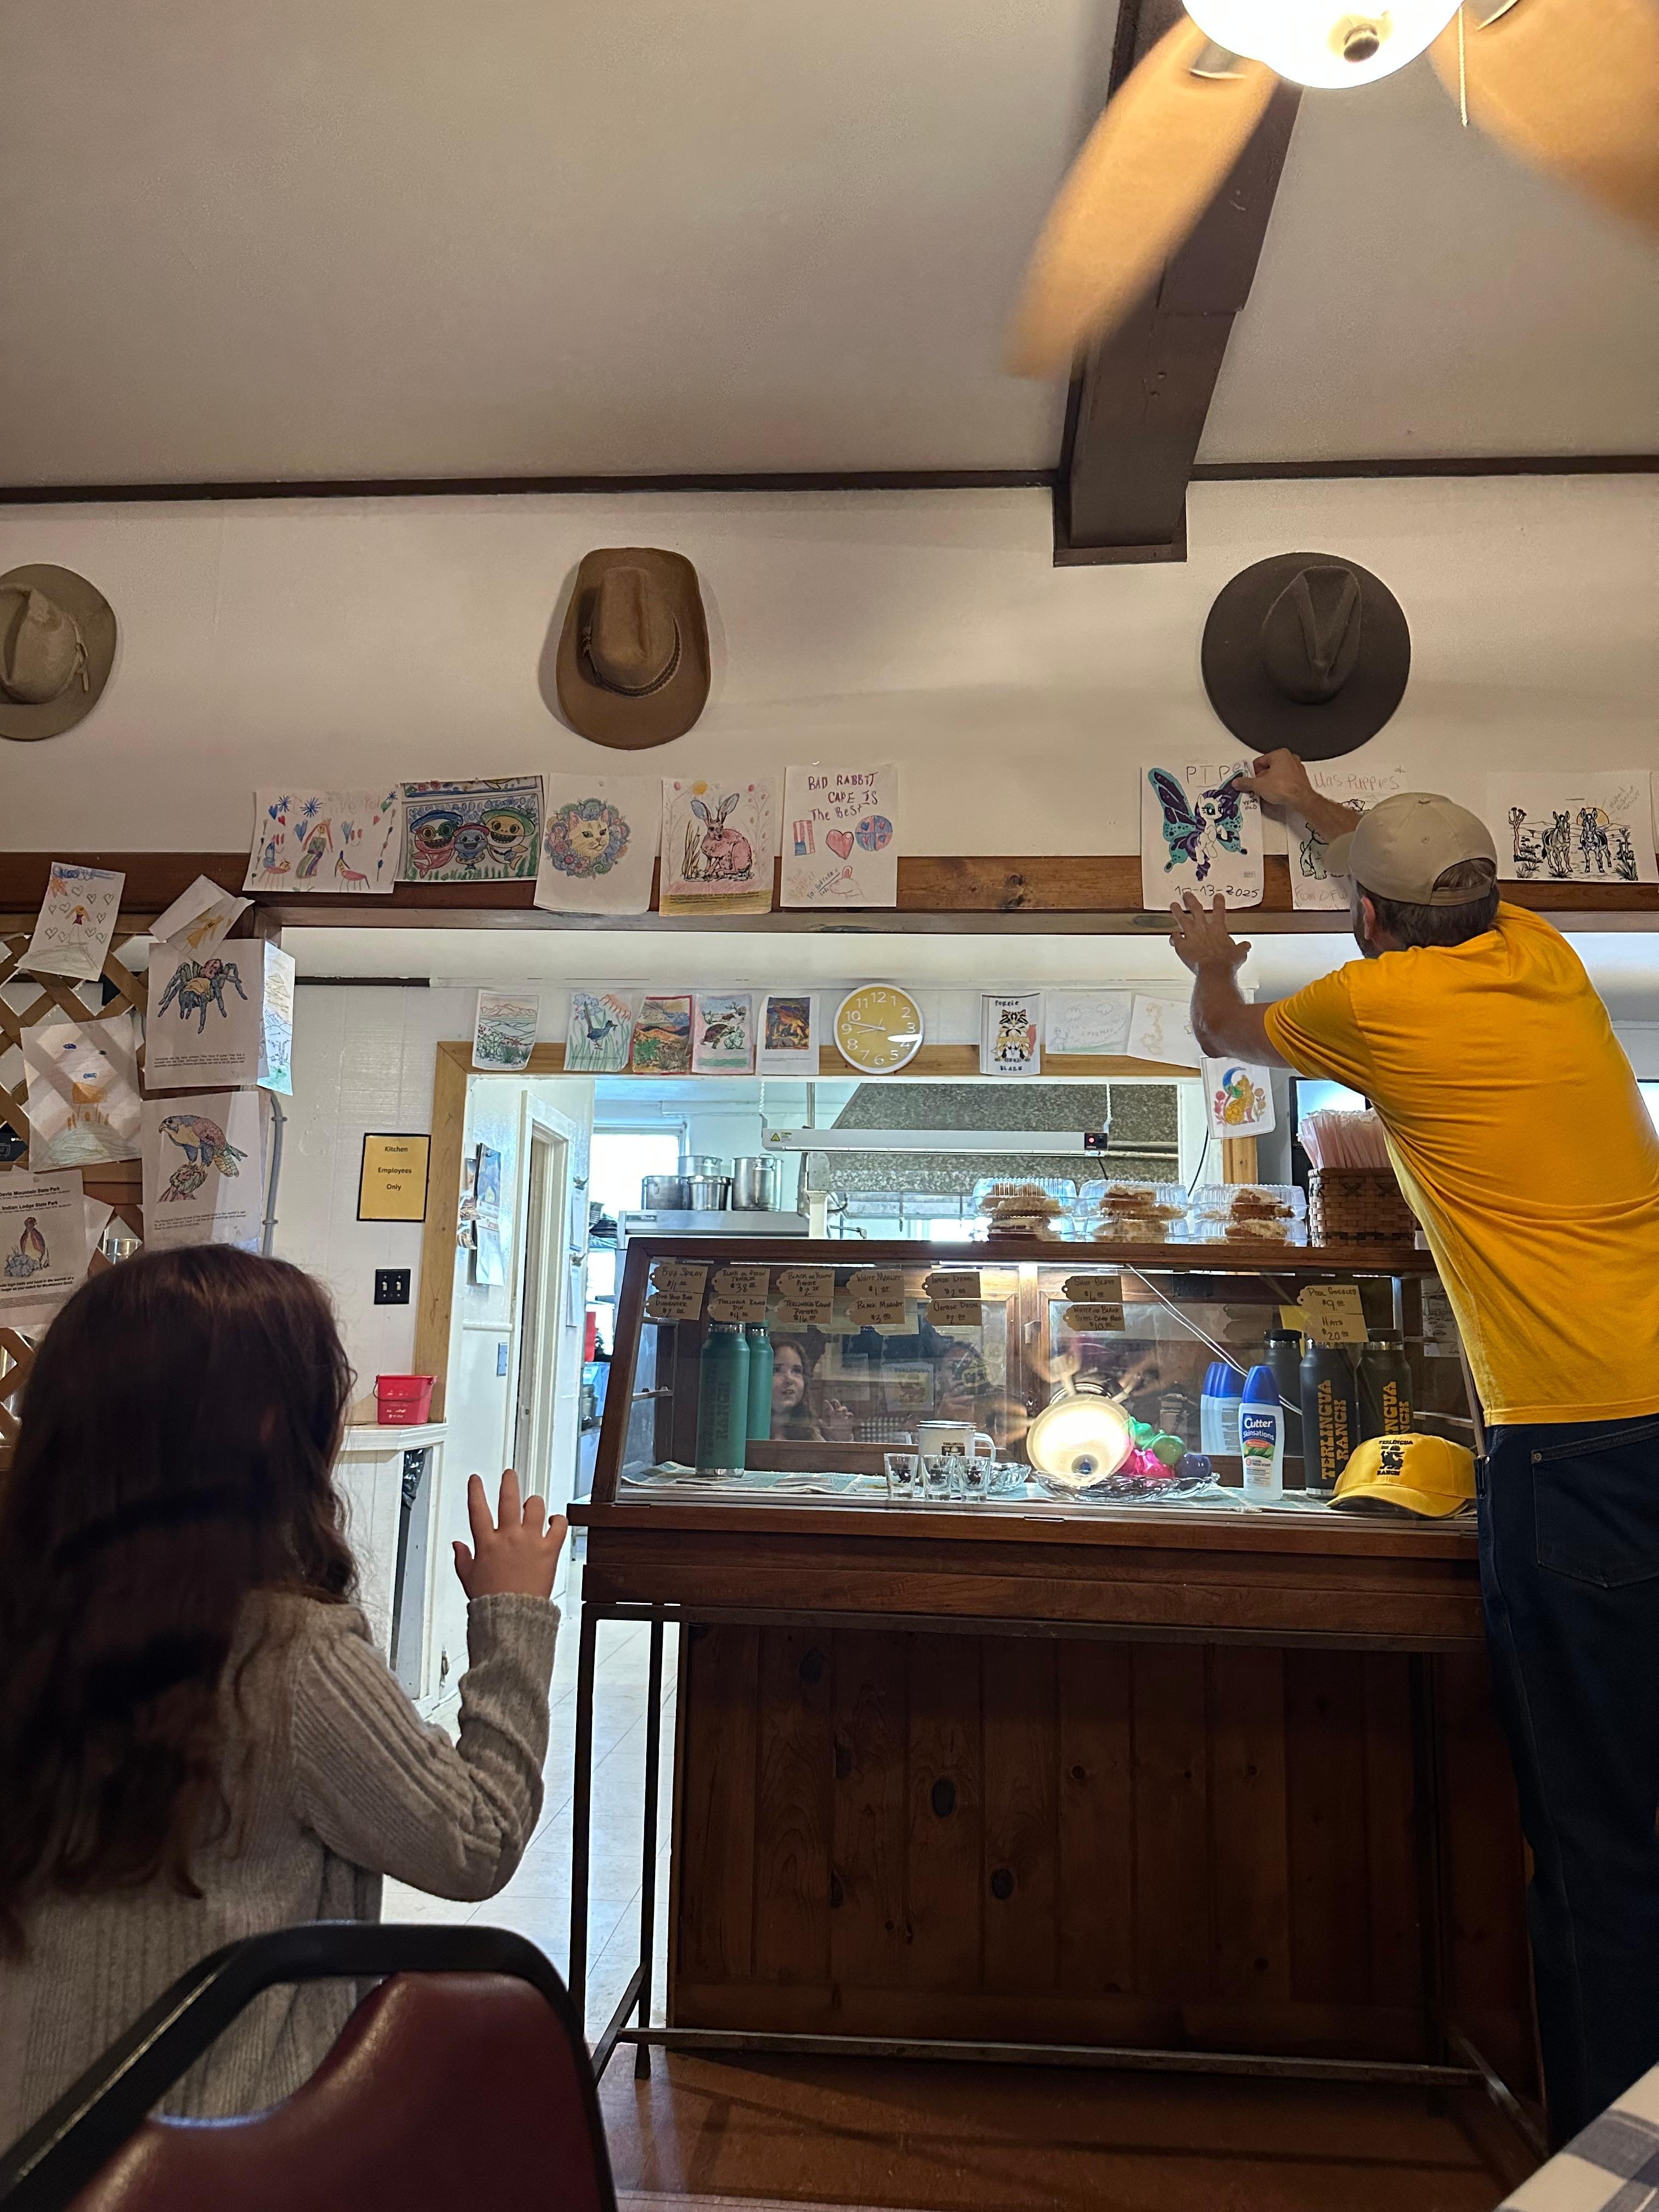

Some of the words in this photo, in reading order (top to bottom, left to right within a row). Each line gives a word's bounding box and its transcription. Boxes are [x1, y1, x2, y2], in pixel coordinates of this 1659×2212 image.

[809, 776, 828, 790] BAD
[837, 771, 878, 787] RABBIT
[861, 790, 878, 805] IS
[809, 808, 831, 821] The
[856, 998, 868, 1008] 11
[871, 991, 887, 1003] 12
[891, 995, 896, 1006] 1
[845, 1011, 861, 1022] 10
[901, 1007, 911, 1018] 2
[841, 1023, 852, 1035] 9
[906, 1022, 916, 1033] 3
[847, 1039, 859, 1050] 8
[860, 1049, 870, 1061] 7
[874, 1054, 884, 1065] 6
[890, 1050, 899, 1060] 5
[1306, 1288, 1327, 1296] POOL
[1244, 1417, 1273, 1430] Cutter
[1318, 1379, 1336, 1480] TERLINGUA
[1242, 1429, 1275, 1441] Skinsations
[1333, 1400, 1350, 1460] RANCH
